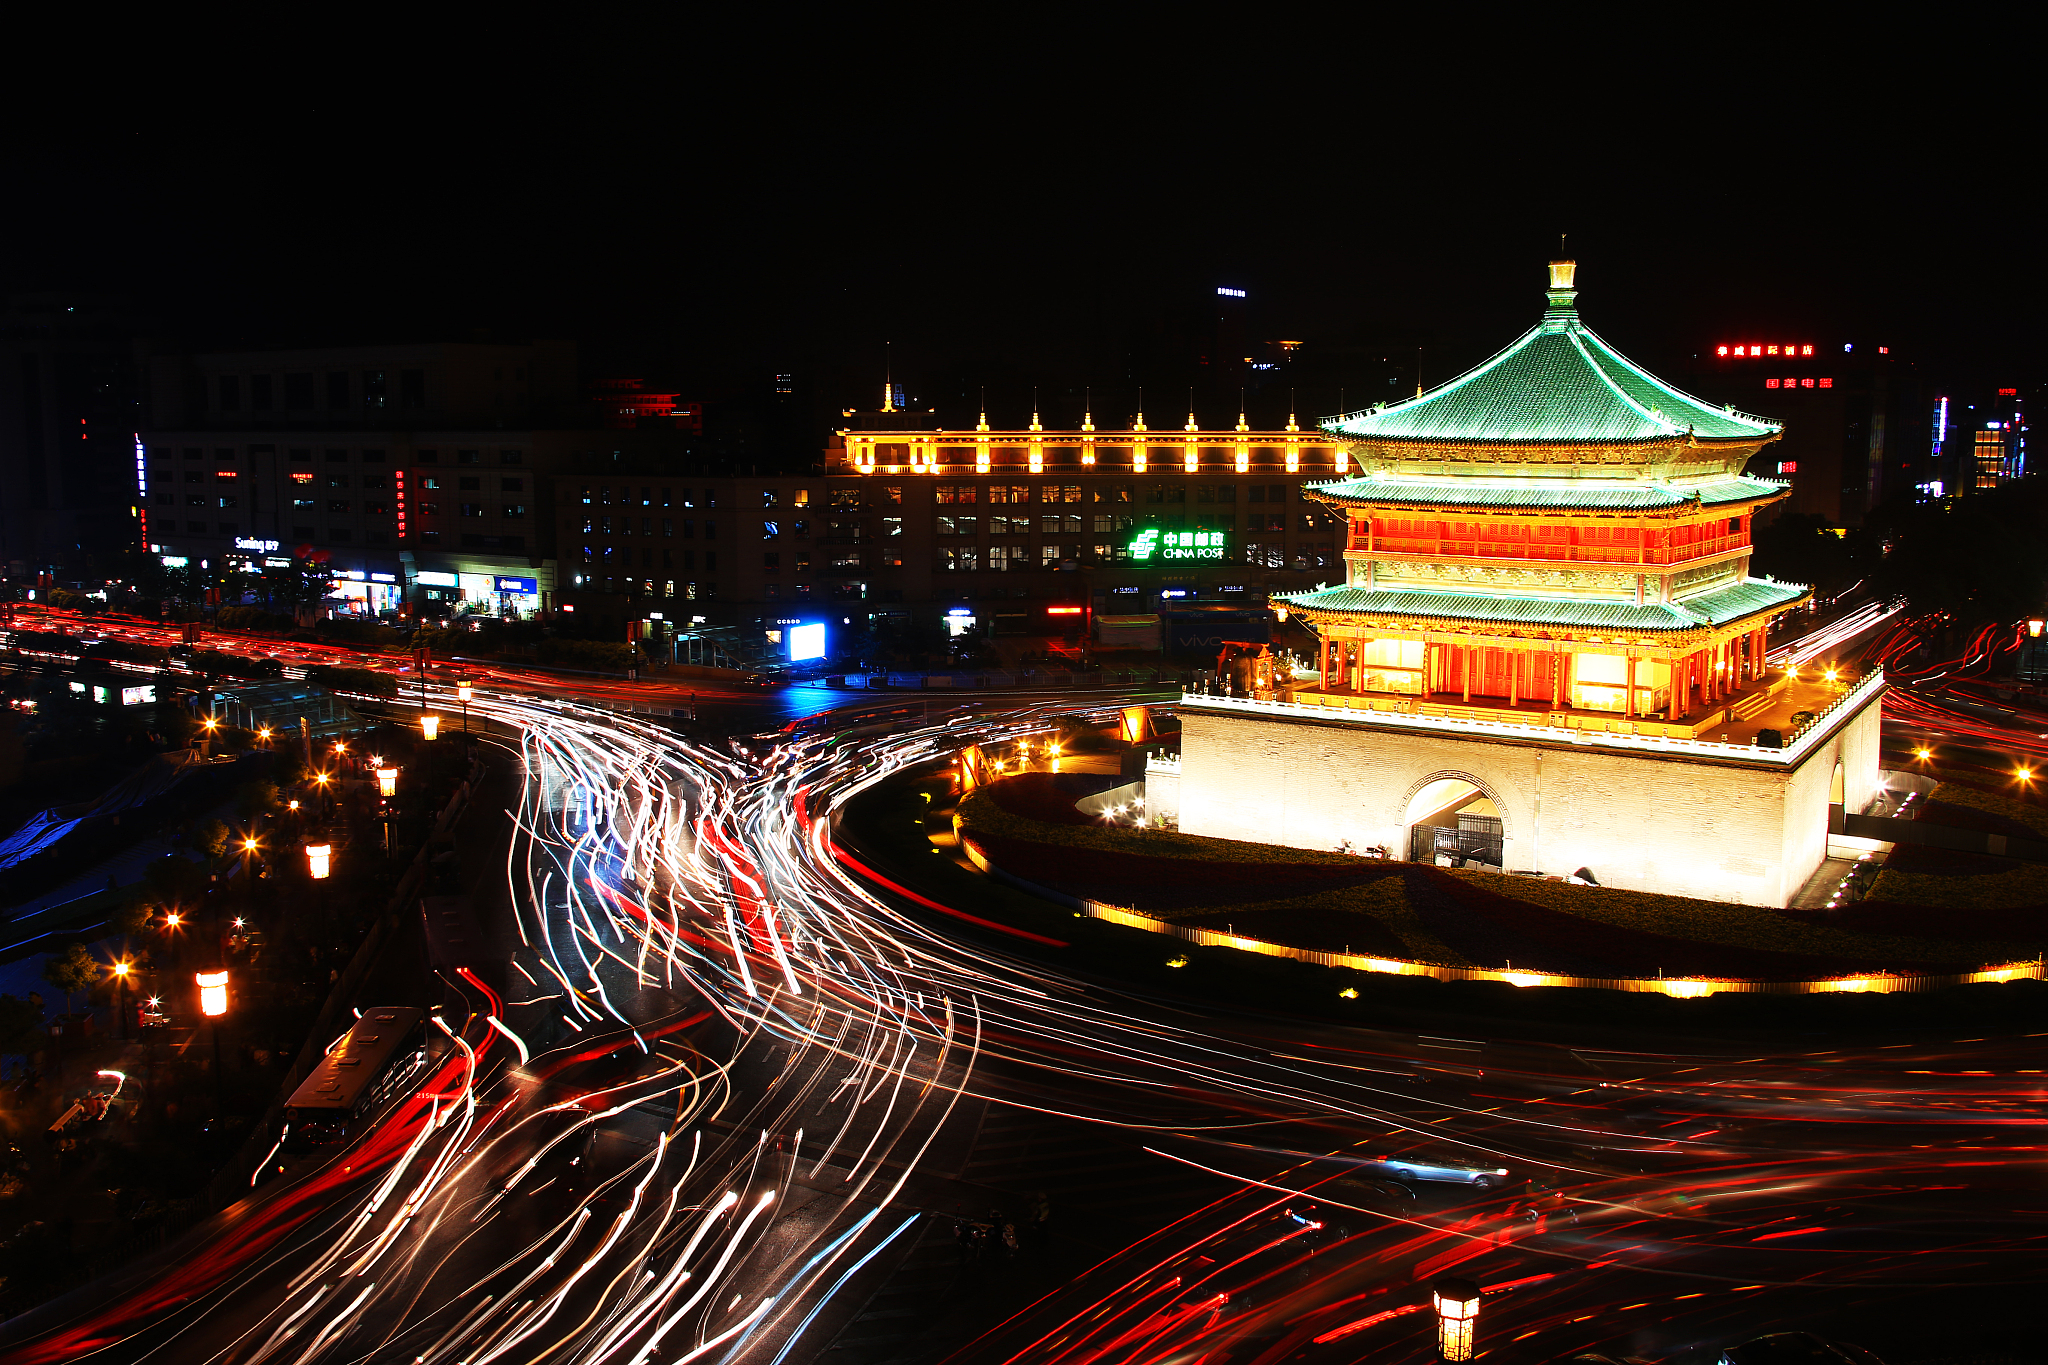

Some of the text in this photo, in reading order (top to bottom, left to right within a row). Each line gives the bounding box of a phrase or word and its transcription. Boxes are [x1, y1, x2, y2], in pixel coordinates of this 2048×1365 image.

[1766, 378, 1833, 389] 国美电器
[1163, 531, 1225, 547] 中国邮政
[1163, 547, 1224, 559] CHINA POST
[1180, 634, 1222, 647] vivo
